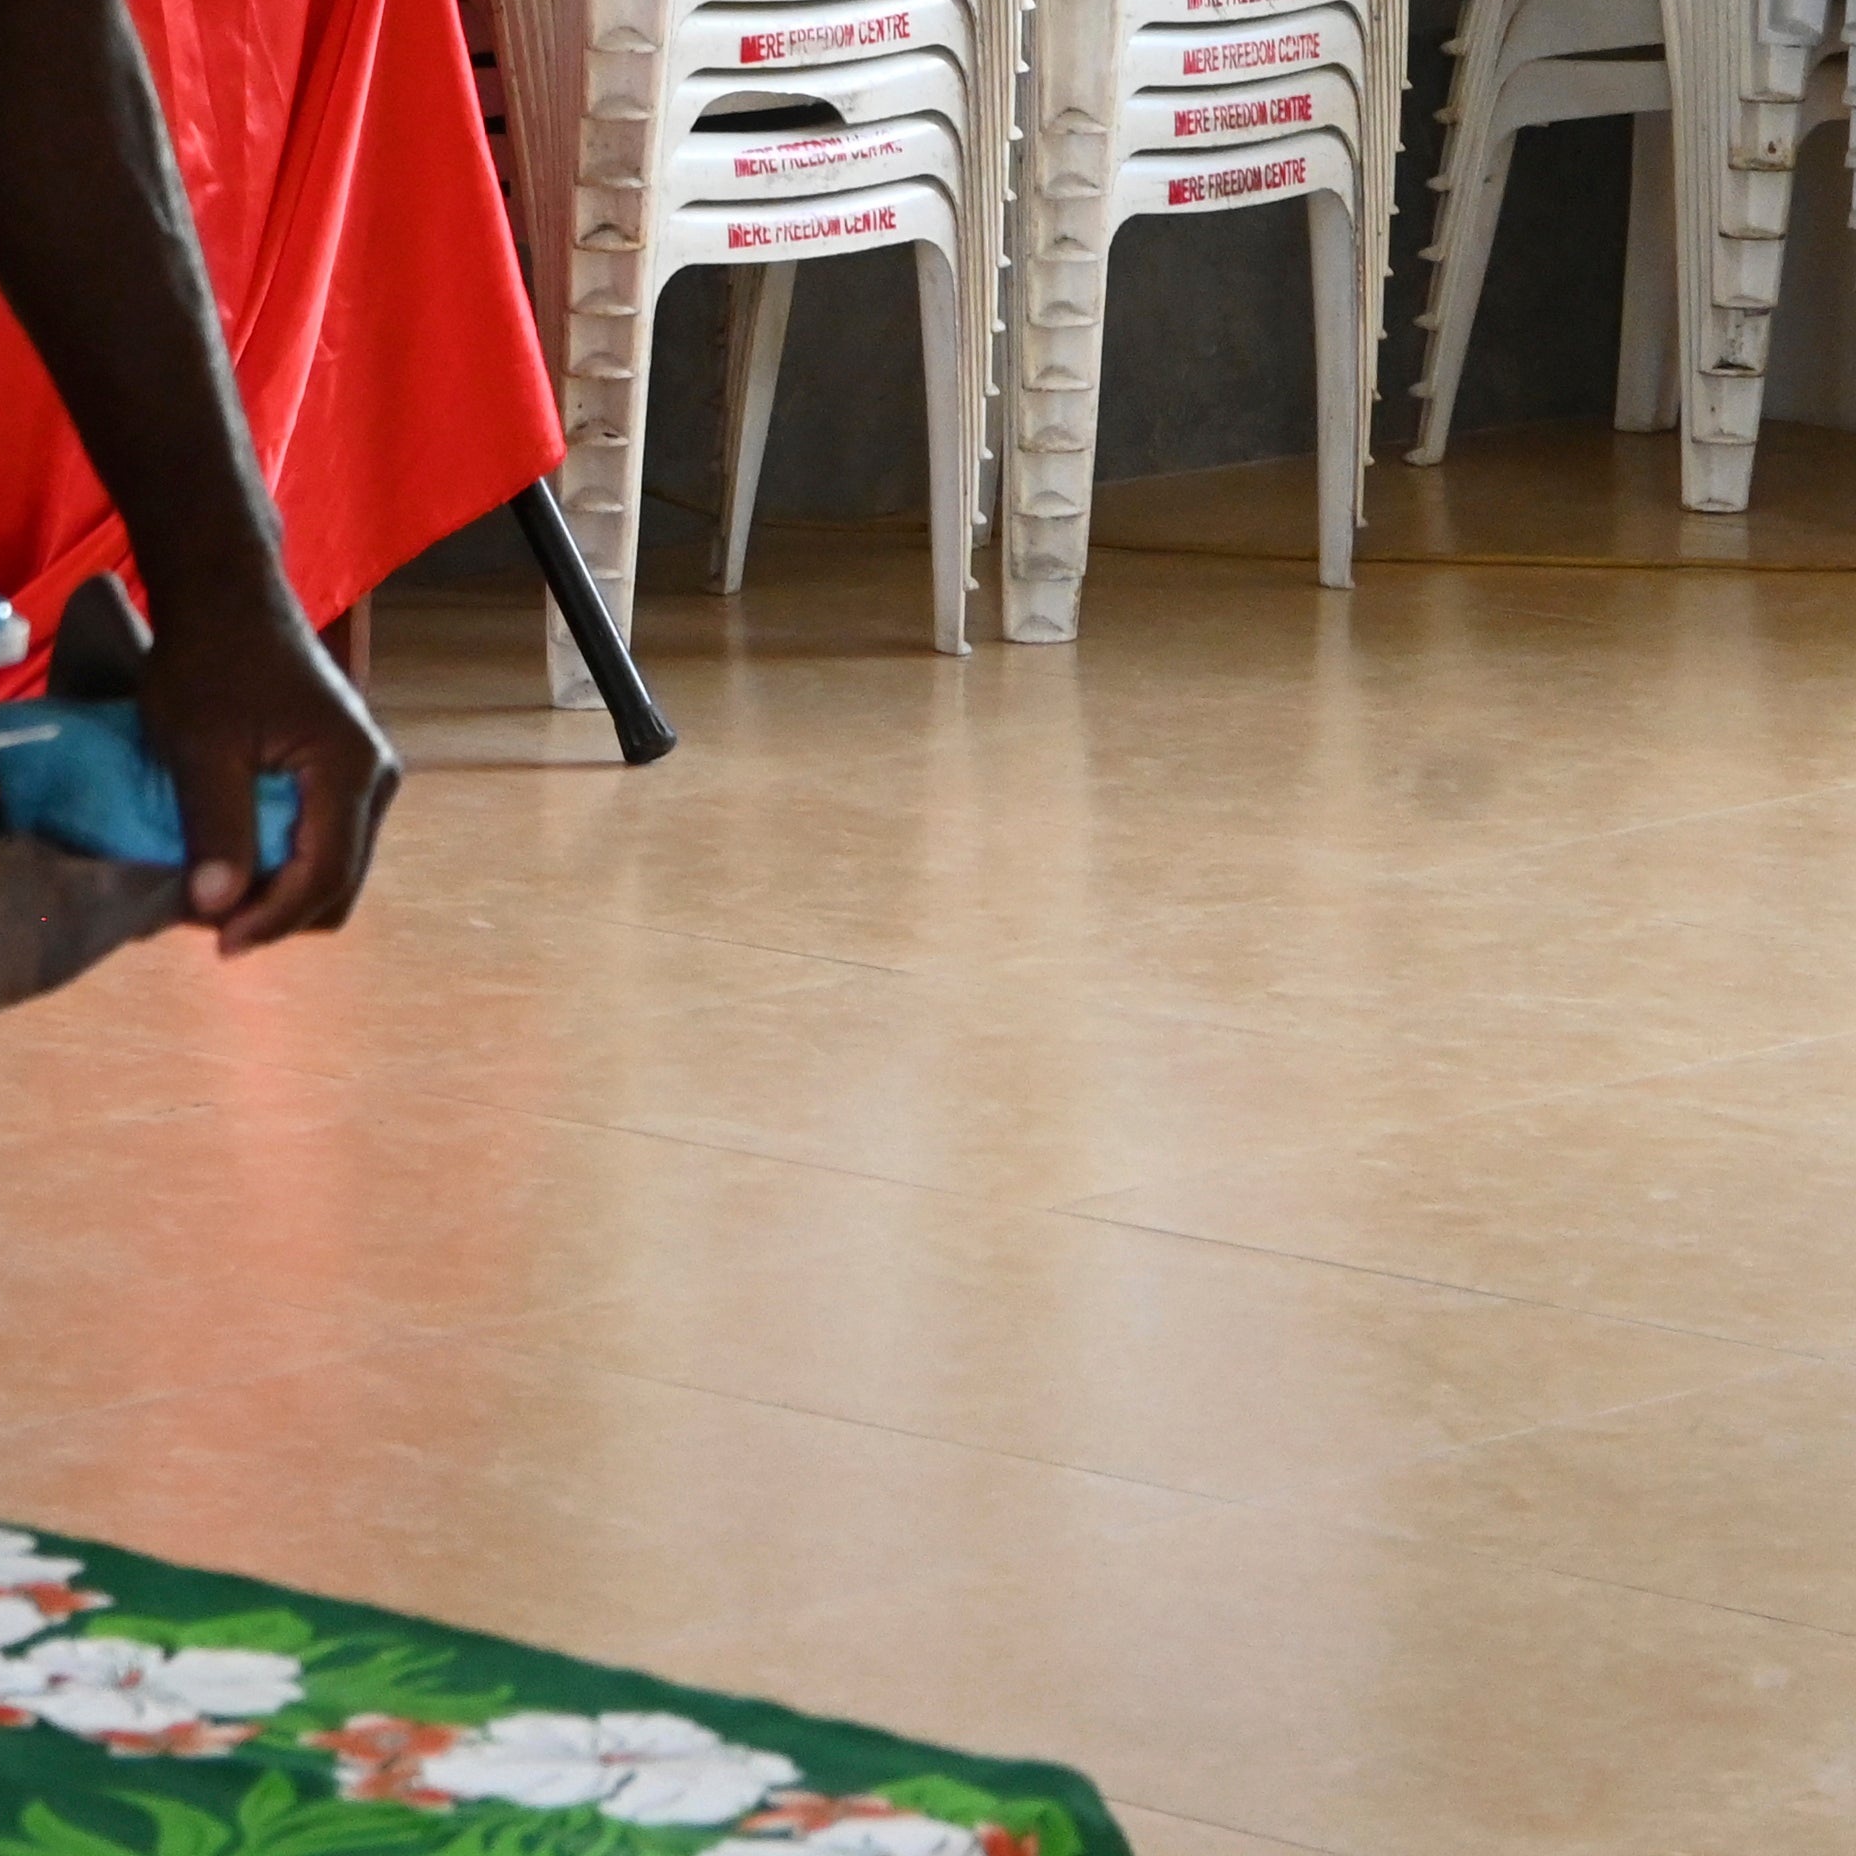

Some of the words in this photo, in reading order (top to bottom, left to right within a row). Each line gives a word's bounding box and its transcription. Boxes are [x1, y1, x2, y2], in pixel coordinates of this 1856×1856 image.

[859, 12, 910, 45] CENTRE
[1222, 39, 1276, 69] FREEDOM
[1213, 101, 1268, 131] FREEDOM
[1270, 94, 1312, 125] CENTRE
[1208, 166, 1263, 199] FREEDOM
[1265, 157, 1306, 190] CENTRE
